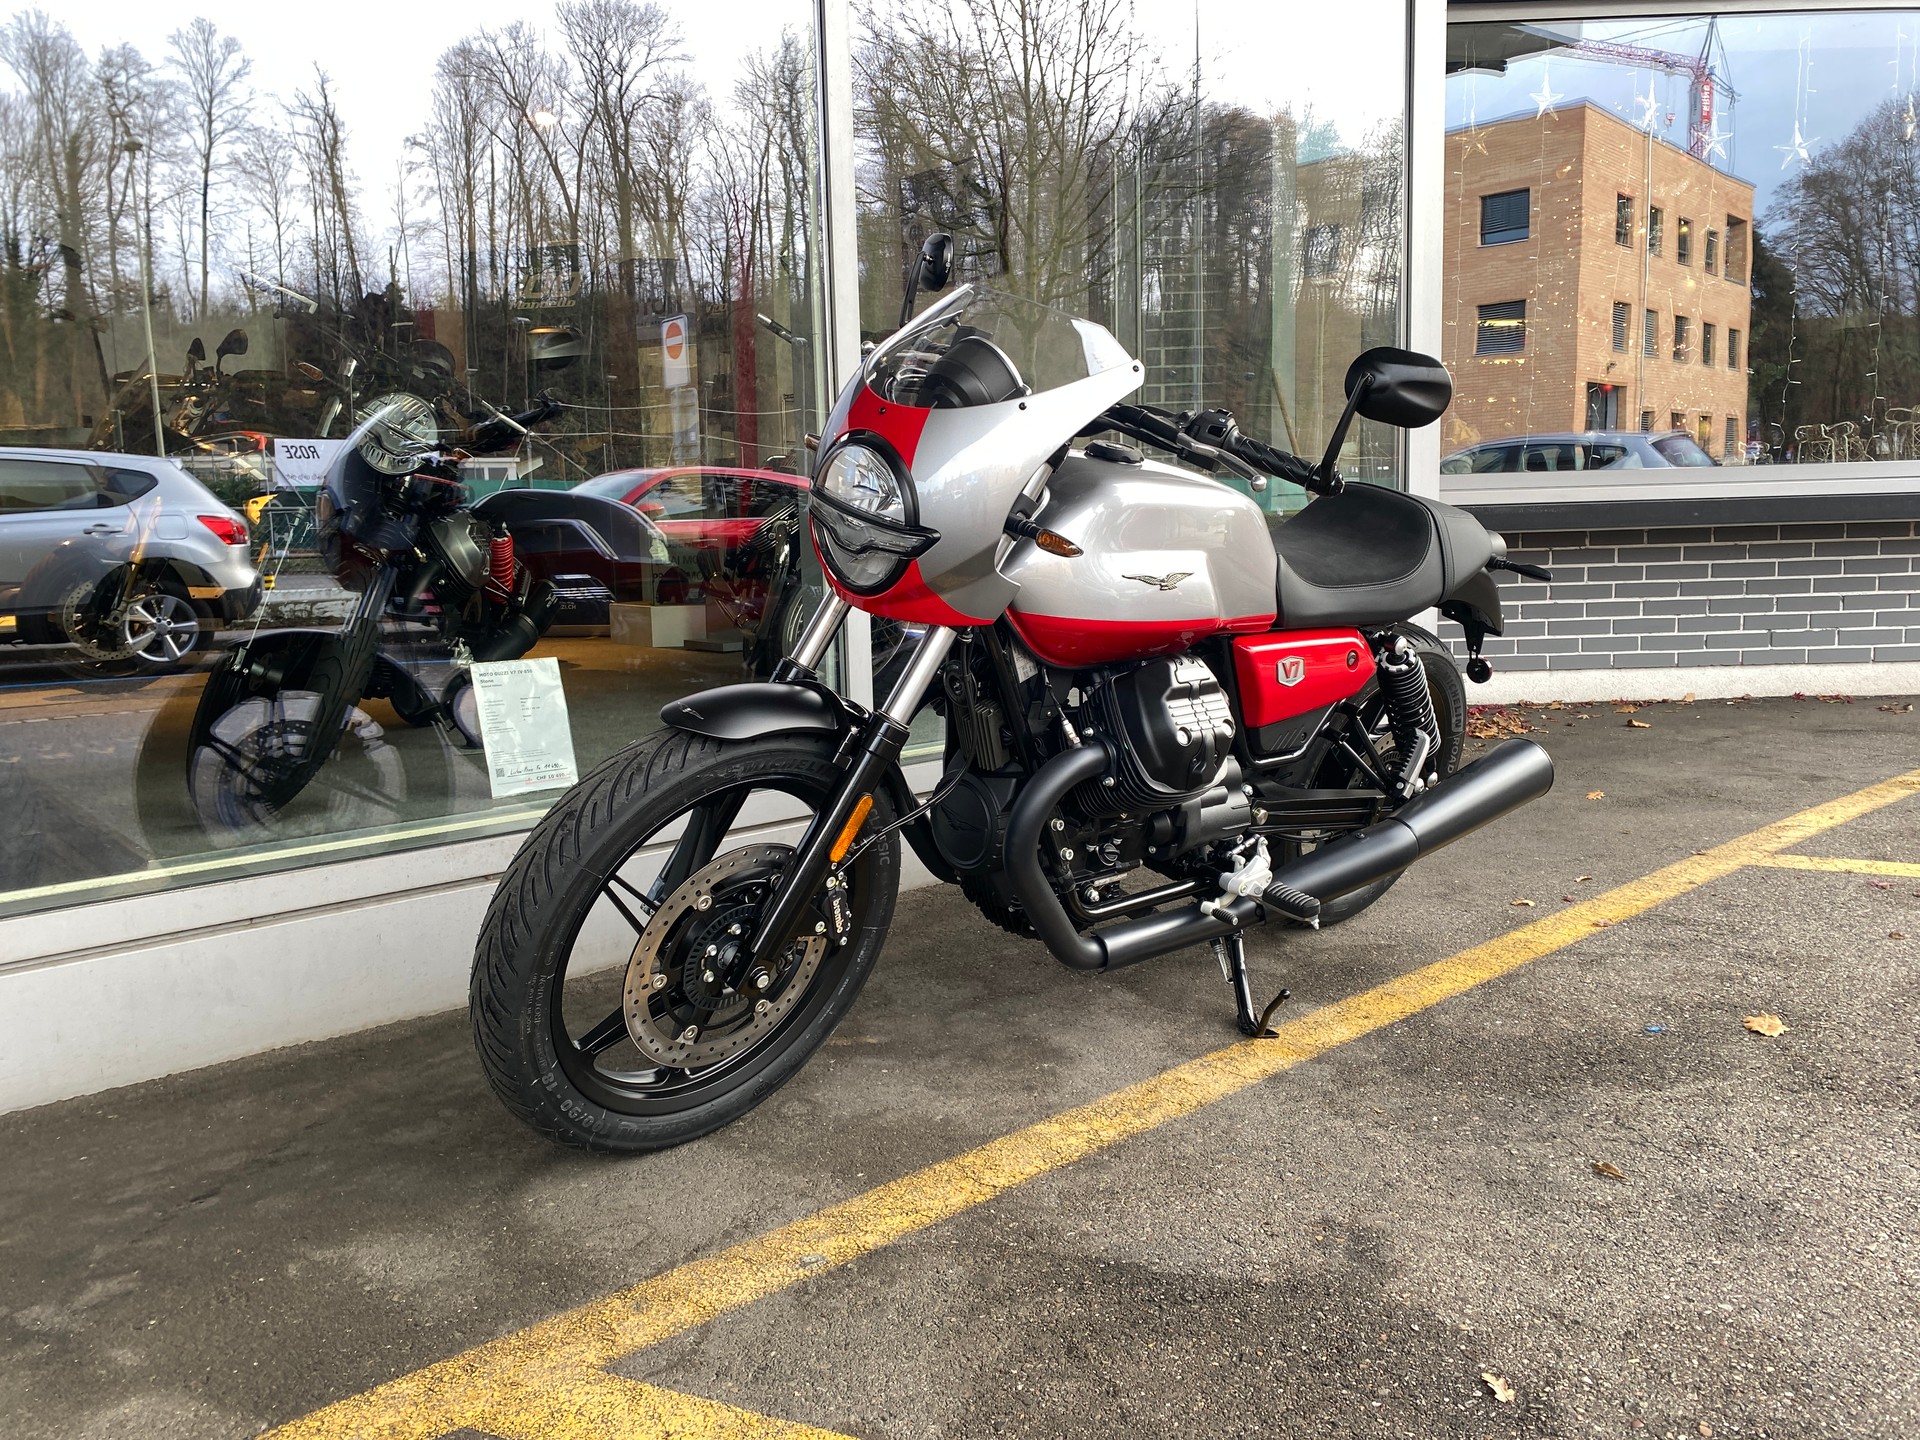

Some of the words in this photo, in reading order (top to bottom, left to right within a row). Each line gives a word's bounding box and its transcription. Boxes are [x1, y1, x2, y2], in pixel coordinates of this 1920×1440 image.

[509, 297, 576, 310] Mandello
[1282, 660, 1301, 679] V7
[1444, 671, 1462, 730] MICHELIN
[1447, 737, 1459, 774] ROAD
[832, 897, 845, 934] brembo
